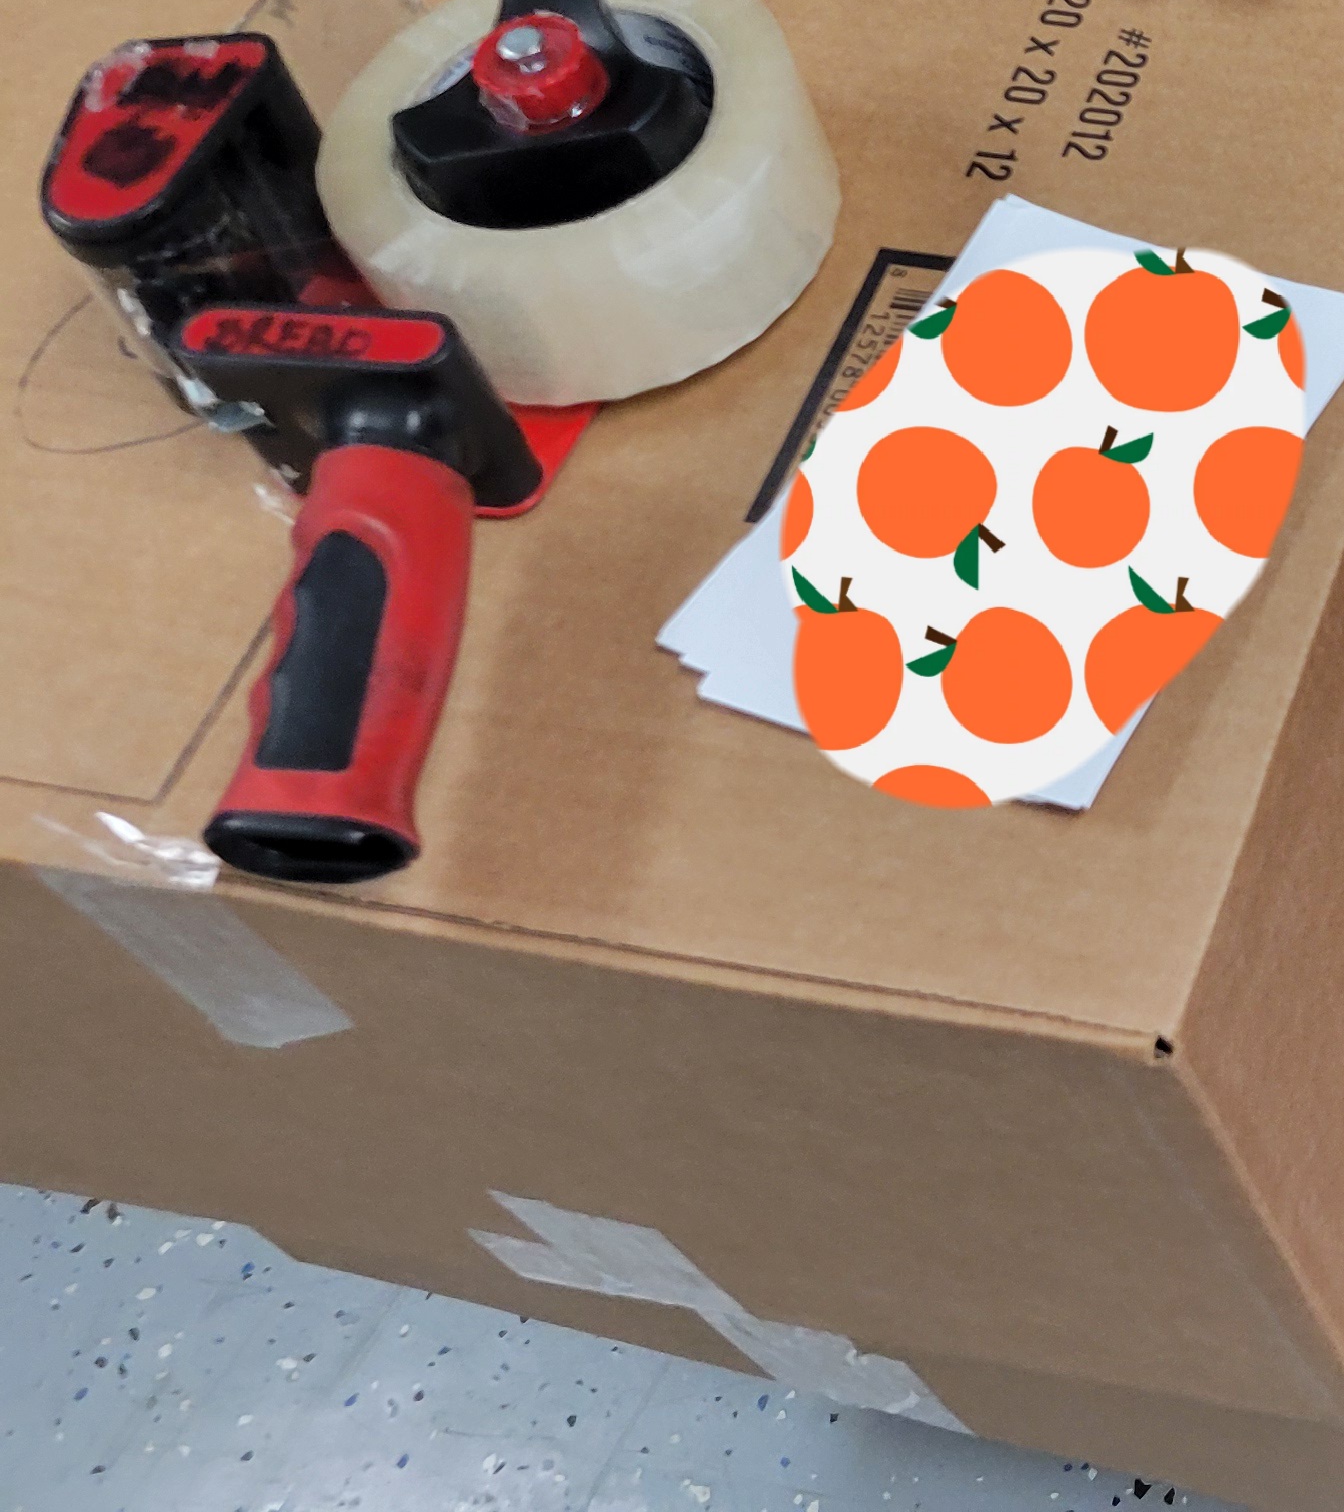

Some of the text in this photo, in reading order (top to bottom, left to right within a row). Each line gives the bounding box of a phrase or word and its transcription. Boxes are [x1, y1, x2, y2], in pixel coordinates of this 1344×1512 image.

[1003, 66, 1056, 107] 20
[1062, 27, 1153, 162] #202012
[966, 149, 1019, 182] 12
[842, 311, 891, 380] 12578
